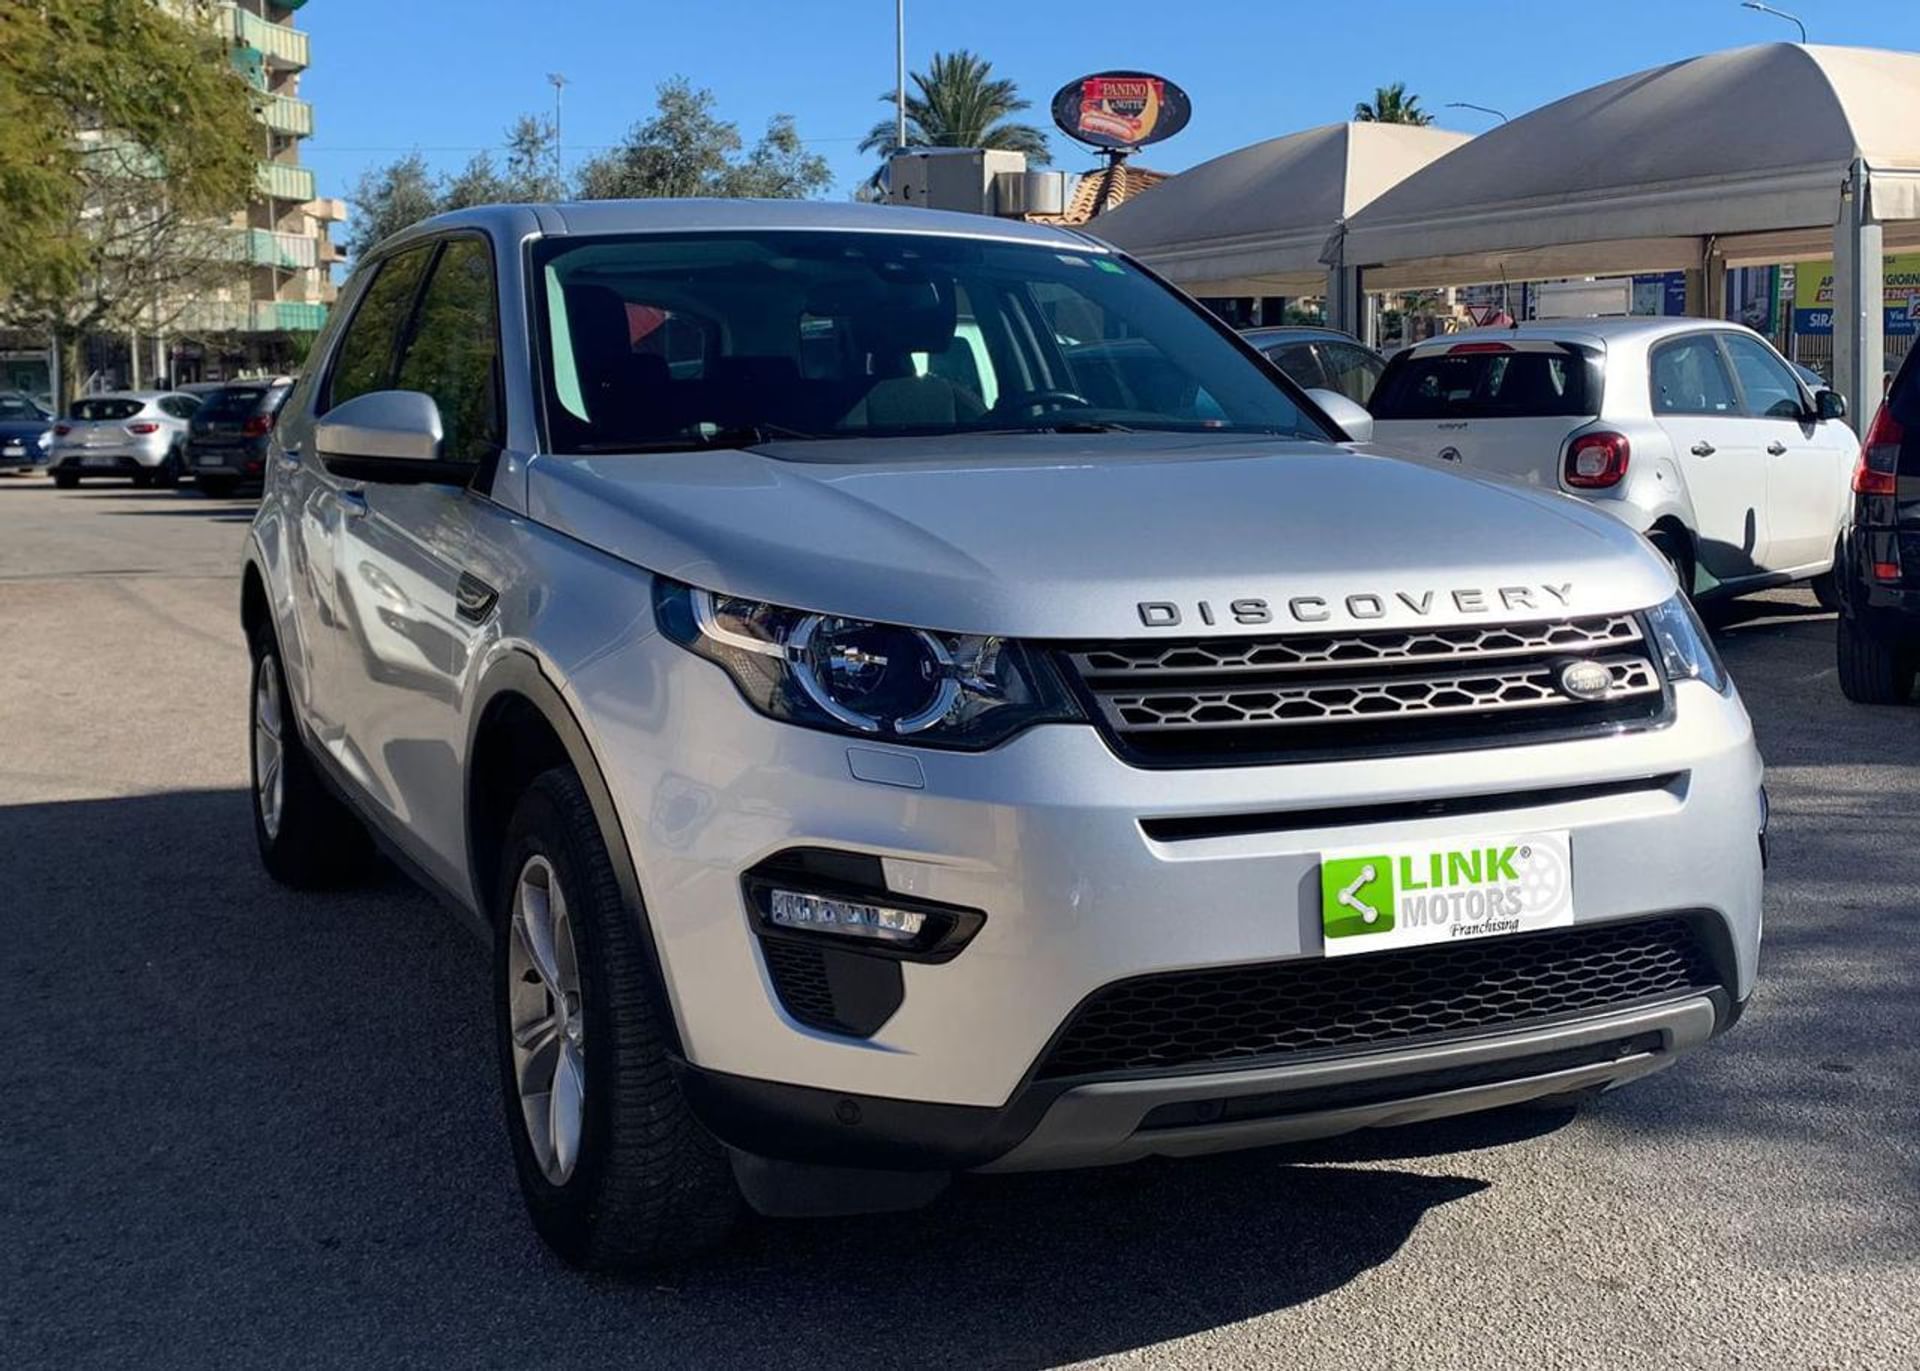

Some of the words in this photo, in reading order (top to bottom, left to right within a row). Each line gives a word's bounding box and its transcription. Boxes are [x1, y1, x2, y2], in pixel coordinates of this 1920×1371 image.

[1103, 82, 1146, 97] PANINO
[1137, 583, 1572, 627] DISCOVERY
[1400, 846, 1519, 891] LINK
[1401, 886, 1523, 928] MOTORS
[1450, 918, 1519, 937] Franchising
